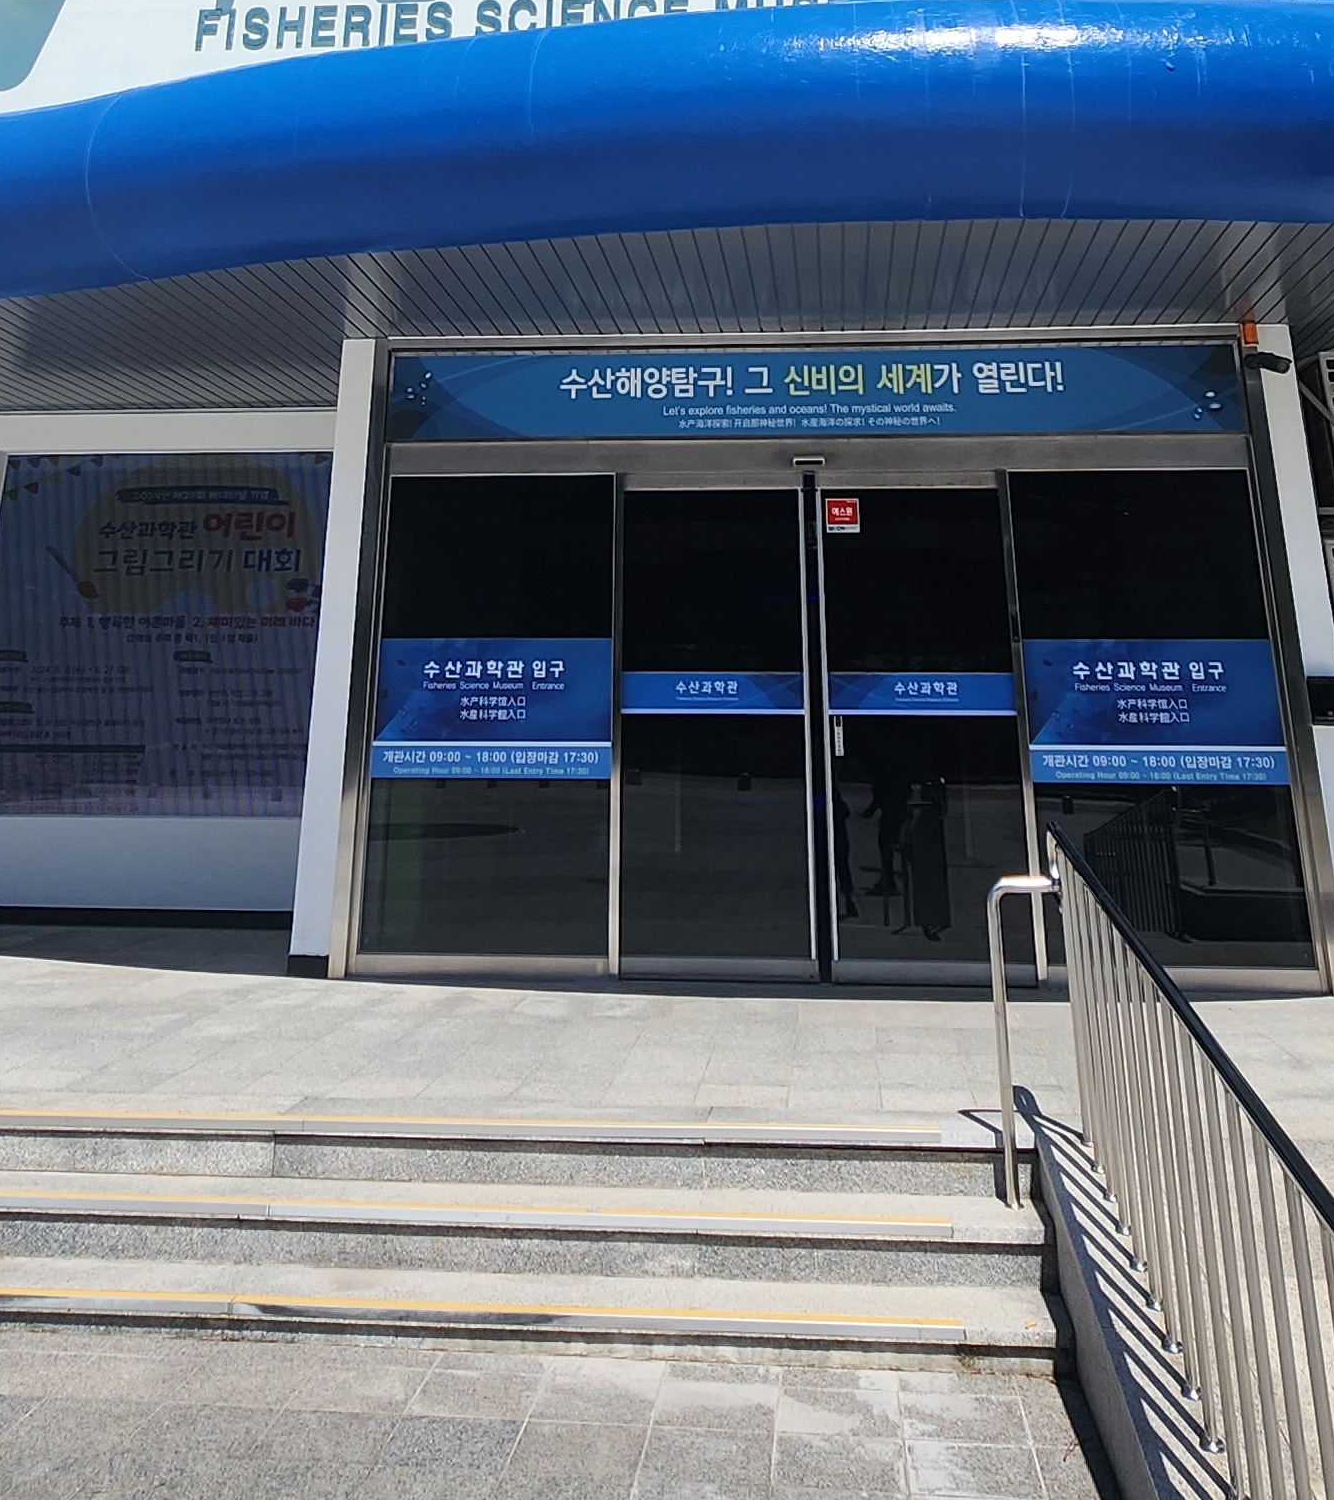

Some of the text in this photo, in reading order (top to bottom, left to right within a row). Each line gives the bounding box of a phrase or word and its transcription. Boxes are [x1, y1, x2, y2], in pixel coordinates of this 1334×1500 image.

[194, 0, 454, 52] FISHERIES
[559, 360, 1065, 399] 수산해양탐구! 그 신비의 세계가 열린다!
[662, 402, 958, 420] Let's explore fisheries and oceans! The mystical world awaits.
[98, 511, 297, 541] 수산과학관 어린이
[93, 547, 303, 576] 그림그리기 대회
[423, 660, 566, 679] 수산과학관 입구
[1073, 660, 1225, 681] 수산과학관 입구
[422, 680, 566, 690] Fisheries Science Museum Entrance
[675, 680, 738, 695] 수산과학관
[893, 681, 958, 696] 수산과학관
[1074, 682, 1228, 693] Fisheries Science Museum Entrance
[382, 750, 427, 765] 개관시간
[429, 750, 461, 763] 09:00
[476, 750, 507, 763] 18:00
[510, 750, 560, 765] (입장마감
[563, 750, 600, 765] 17:30)
[1042, 754, 1090, 768] 개관시간
[1092, 755, 1127, 767] 09:00
[1142, 755, 1176, 768] 18:00
[1179, 755, 1232, 770] (입장마감
[1236, 756, 1276, 770] 17:30)
[393, 766, 430, 776] Operating
[431, 766, 451, 775] Hour
[451, 766, 472, 775] 09:00
[502, 766, 522, 776] (Last
[523, 766, 545, 777] Entry
[546, 766, 565, 775] Time
[566, 766, 590, 776] 17:30)
[1057, 770, 1096, 781] Operating
[1097, 770, 1117, 779] Hour
[1118, 770, 1140, 780] 09:00
[1173, 771, 1195, 781] (Last
[1196, 771, 1218, 782] Entry
[1219, 771, 1239, 781] Time
[1242, 772, 1267, 782] 17:30)
